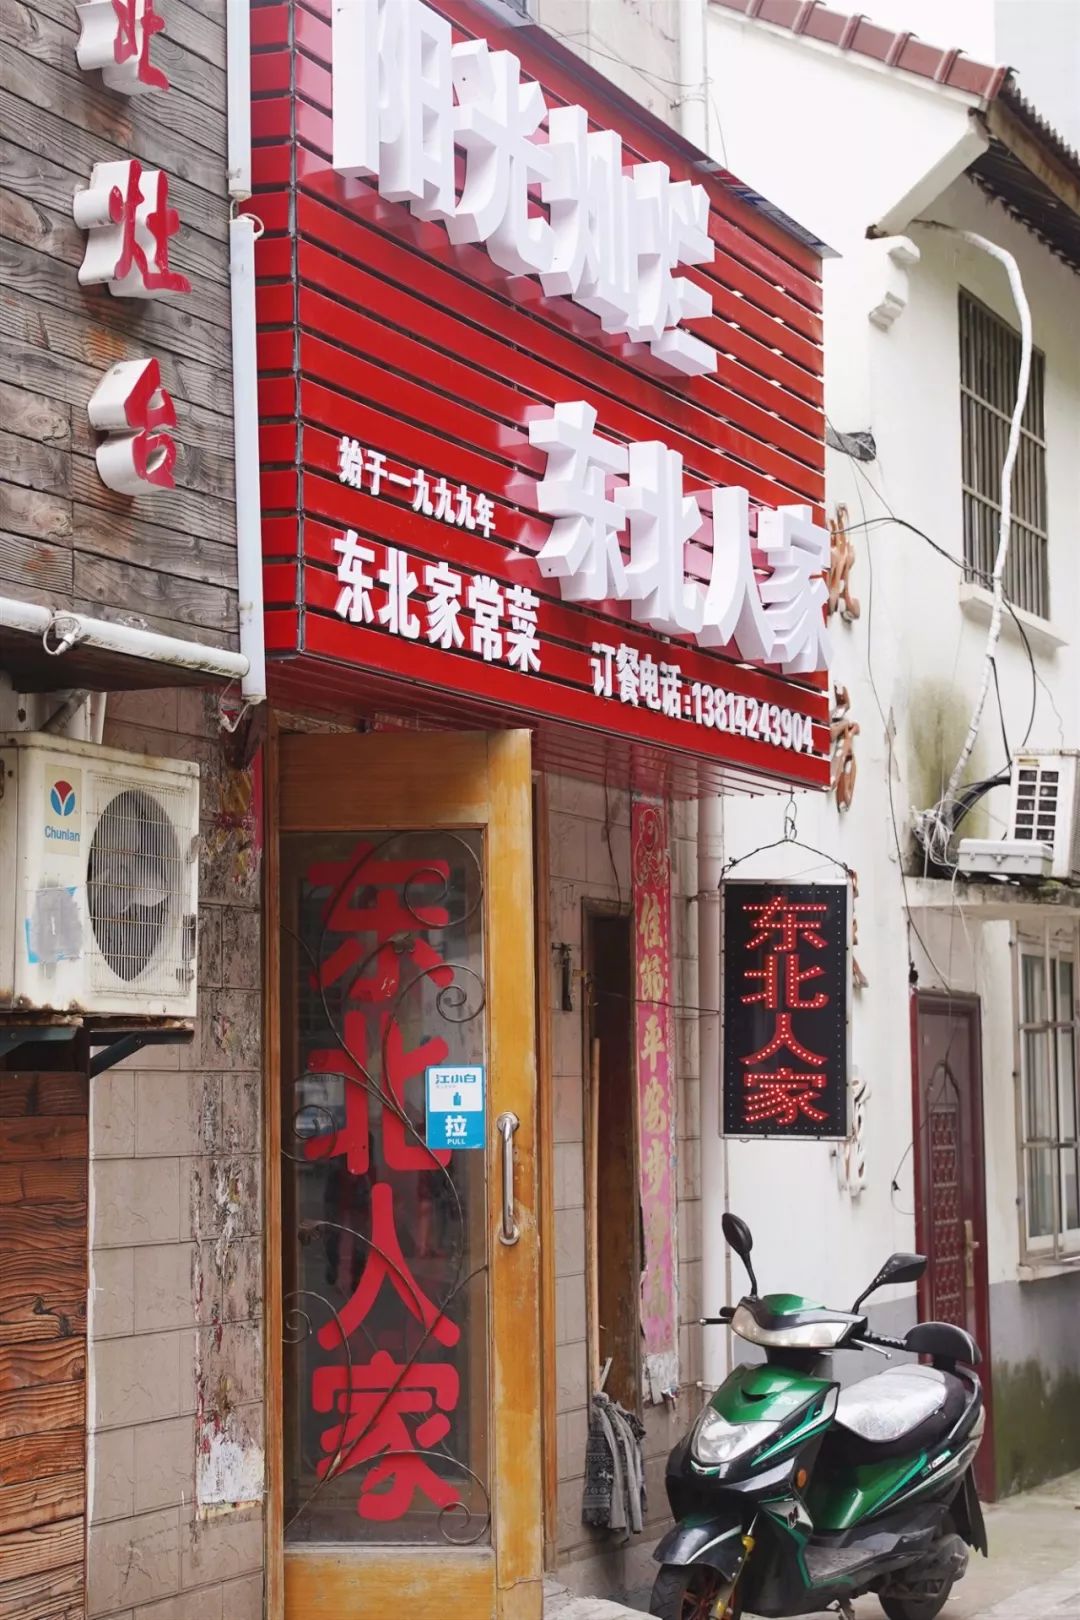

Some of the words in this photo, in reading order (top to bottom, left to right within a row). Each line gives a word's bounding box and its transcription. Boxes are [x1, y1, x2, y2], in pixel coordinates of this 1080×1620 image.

[339, 436, 496, 538] 始于一九九九年
[527, 400, 832, 674] 东北人家
[333, 530, 541, 672] 东北家常菜
[45, 825, 81, 842] Chunlan
[740, 896, 829, 1125] 东北人家
[436, 1073, 477, 1085] 江小白
[445, 1114, 468, 1137] 拉
[305, 841, 462, 1520] 东北人家
